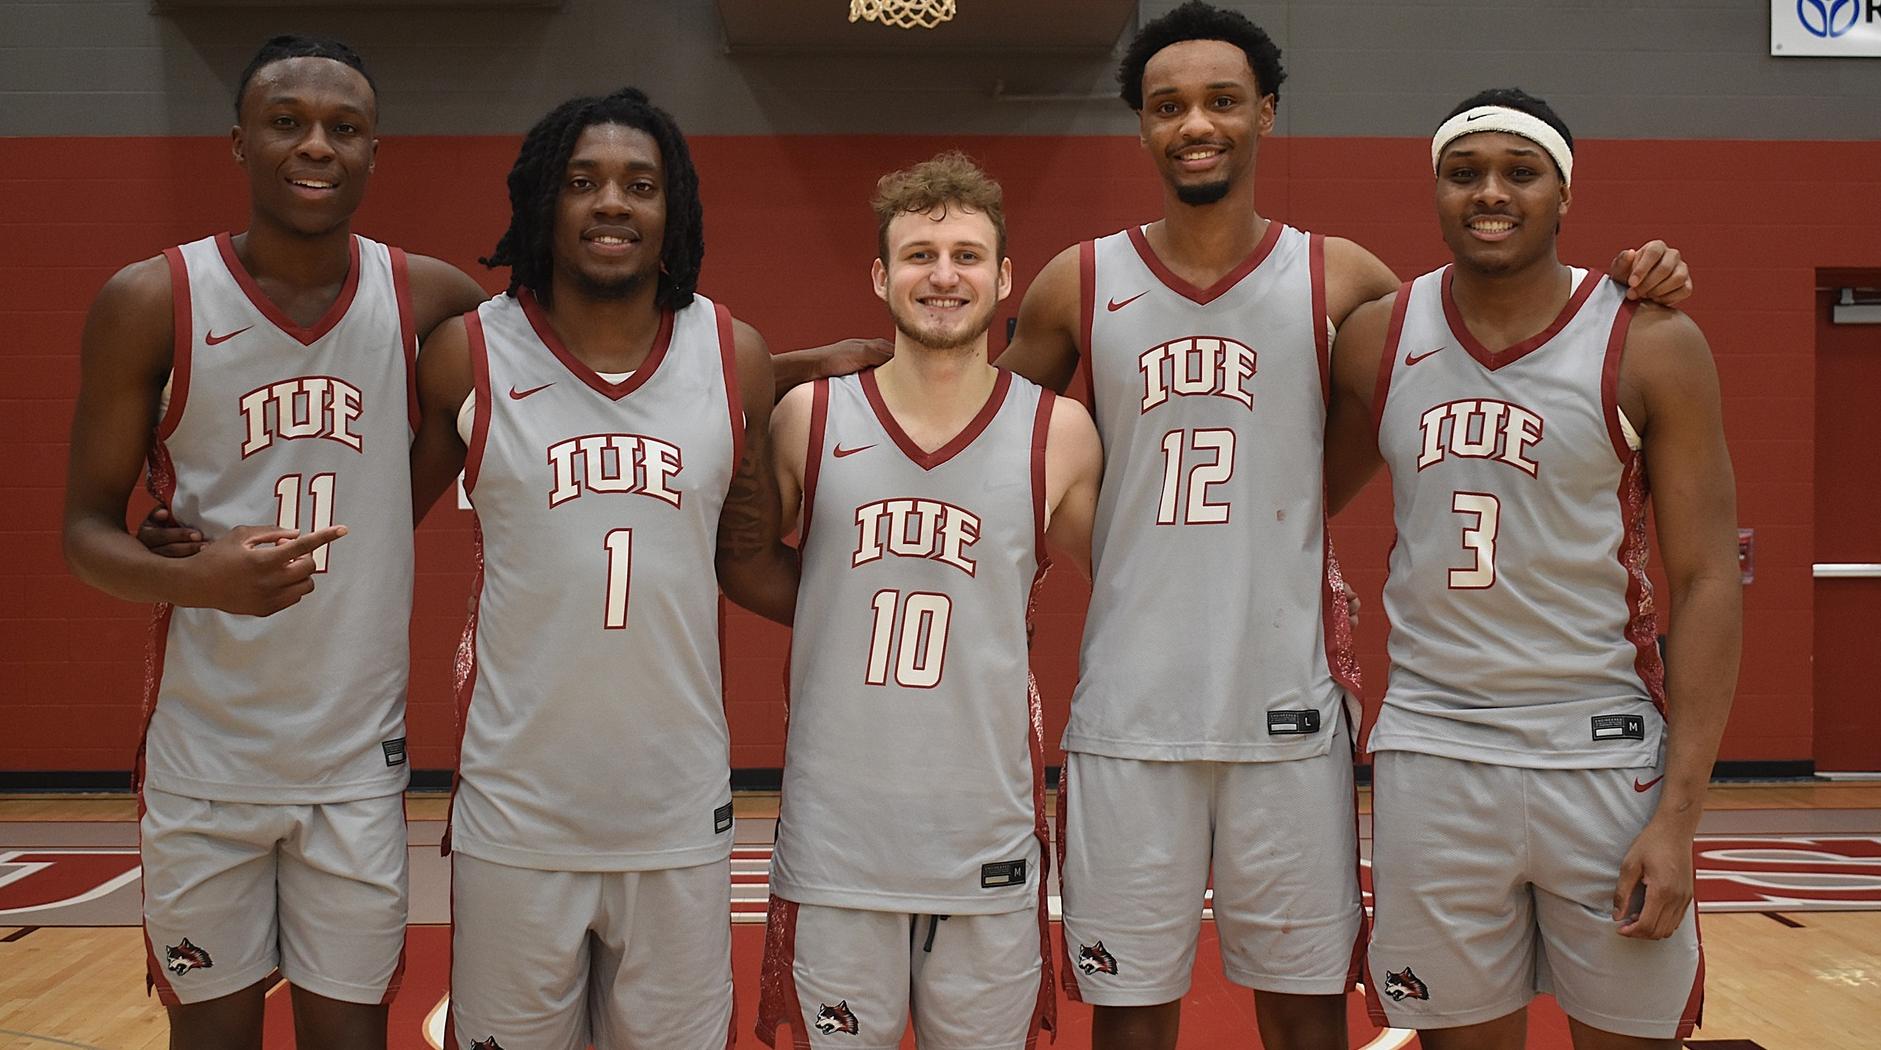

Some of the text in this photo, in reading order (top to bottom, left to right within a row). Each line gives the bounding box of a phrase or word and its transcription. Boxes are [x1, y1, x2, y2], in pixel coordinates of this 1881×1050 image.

[1138, 335, 1257, 415] IUE
[239, 375, 363, 460] IUE
[1417, 397, 1544, 480] IUE
[547, 433, 683, 510] IUE
[1156, 427, 1236, 525] 12
[274, 472, 336, 573] 11
[852, 497, 981, 578] IUE
[1448, 491, 1501, 589] 3
[604, 527, 633, 629] 1
[865, 588, 952, 689] 10
[1304, 717, 1311, 726] L
[1628, 722, 1638, 731] M
[1014, 867, 1021, 877] M
